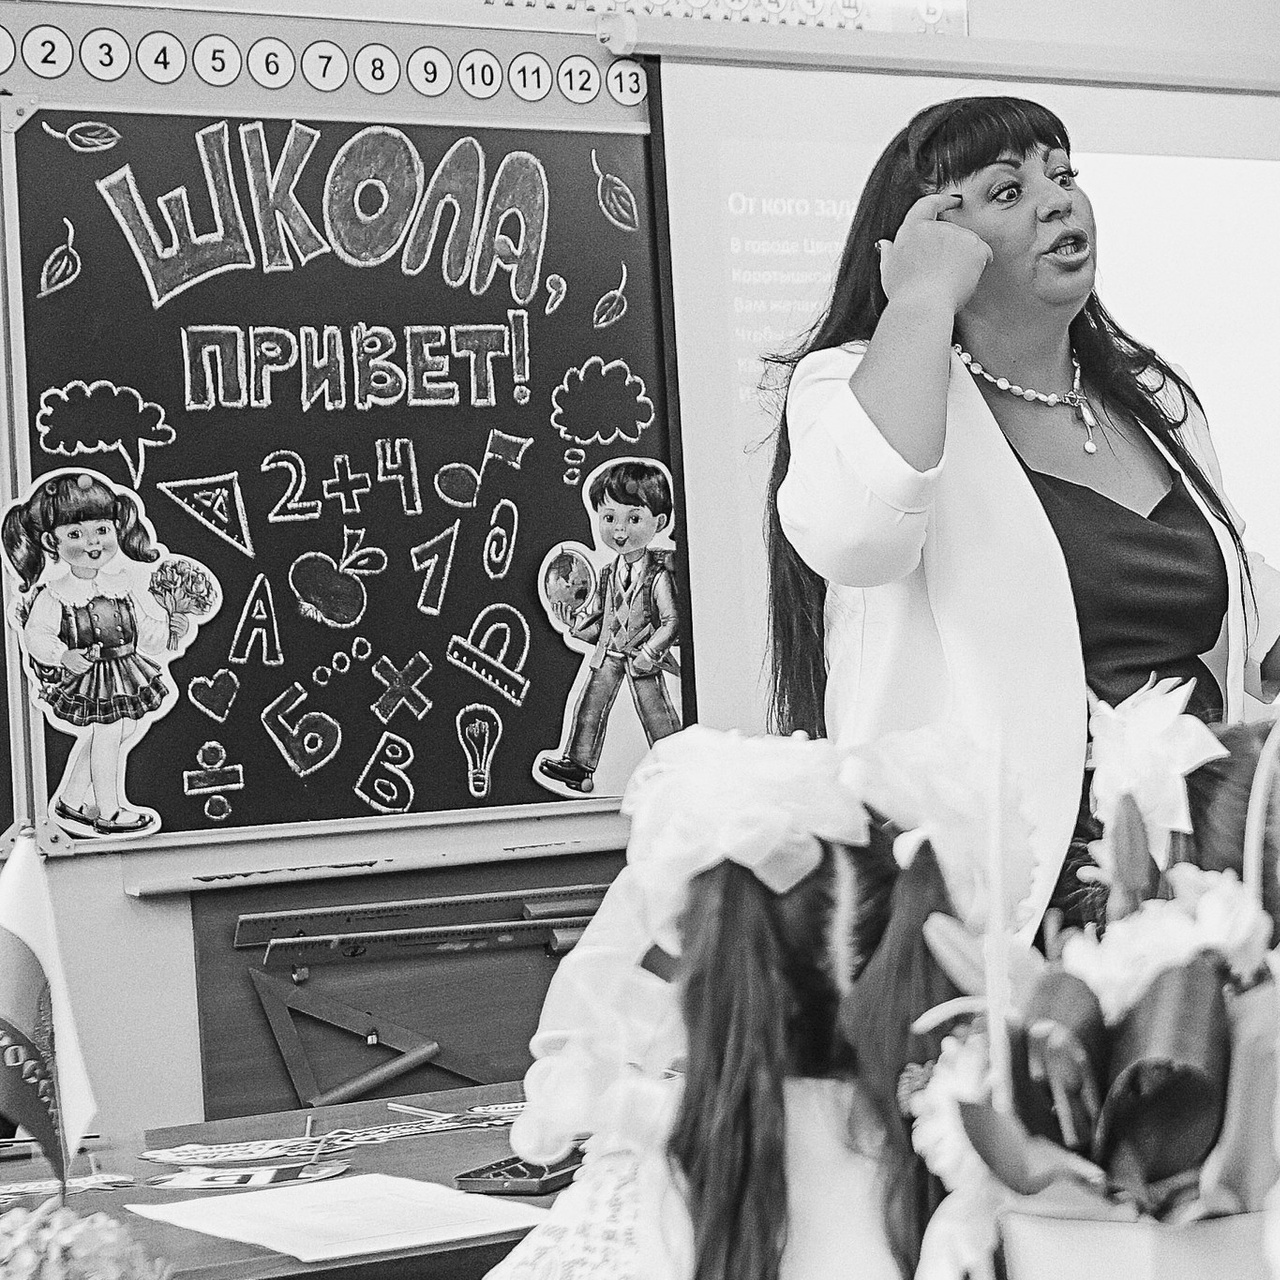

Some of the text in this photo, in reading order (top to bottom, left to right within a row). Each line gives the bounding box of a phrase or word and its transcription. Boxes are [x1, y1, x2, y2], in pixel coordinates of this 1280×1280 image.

[40, 39, 642, 96] 2 3 4 5 6 7 8 9 10 11 12 13
[97, 120, 567, 314] ШКОЛА,
[728, 192, 756, 216] От
[761, 197, 810, 217] кого
[181, 307, 531, 411] ПРИВЕТ!
[228, 573, 285, 666] А
[260, 682, 343, 778] Б
[353, 731, 415, 815] В
